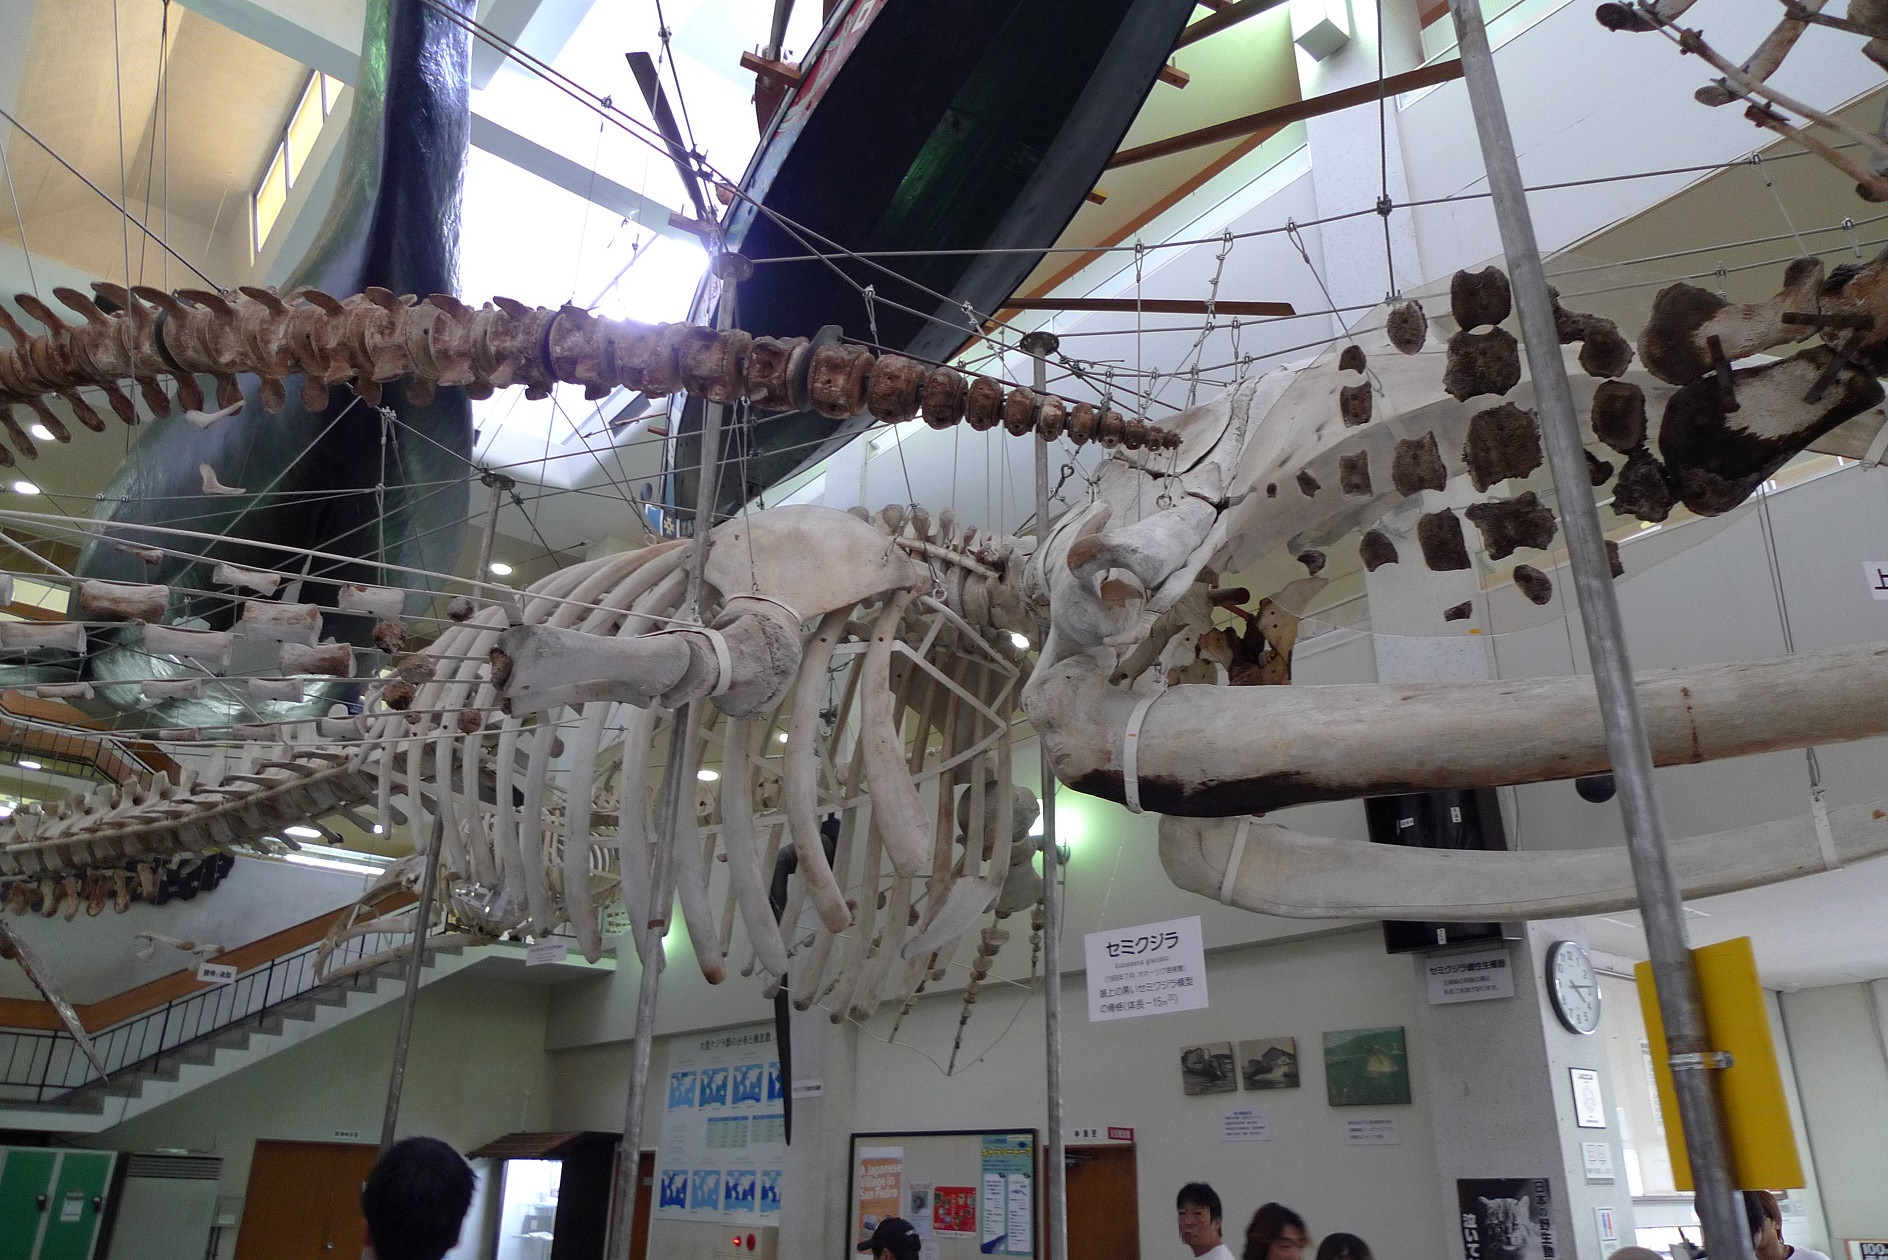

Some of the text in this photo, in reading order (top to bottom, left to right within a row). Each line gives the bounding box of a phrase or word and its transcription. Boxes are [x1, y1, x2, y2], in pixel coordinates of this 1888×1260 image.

[1106, 931, 1179, 958] セミクジラ
